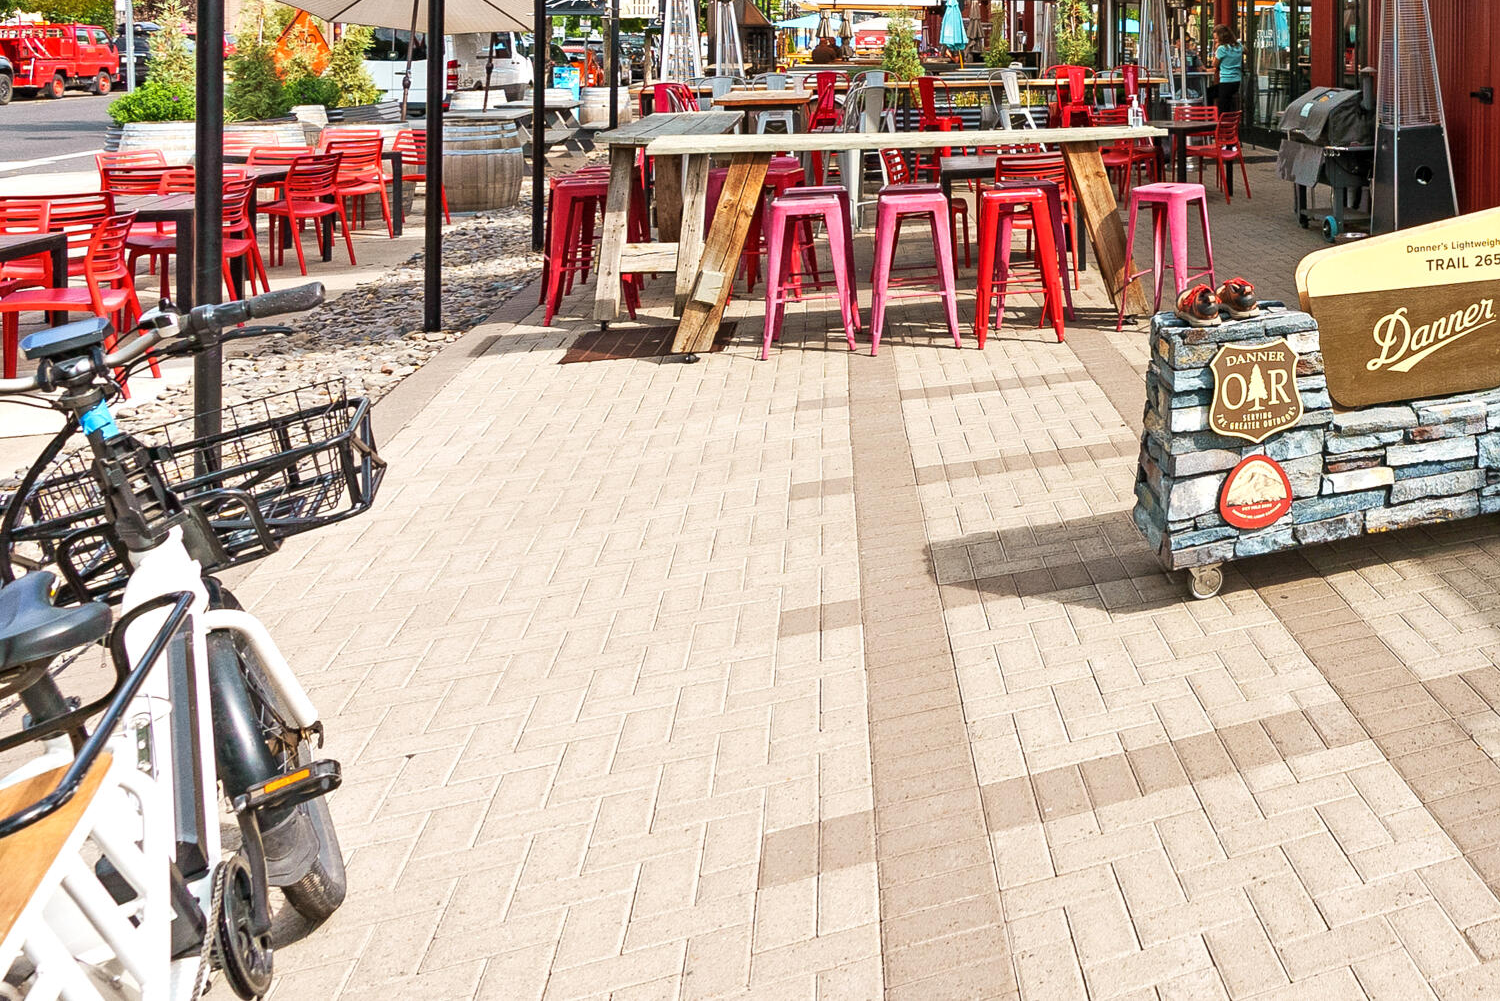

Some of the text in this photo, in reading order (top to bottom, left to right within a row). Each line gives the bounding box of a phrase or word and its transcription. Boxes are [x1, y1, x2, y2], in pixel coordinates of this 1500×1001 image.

[1407, 243, 1448, 254] Danner's
[1426, 257, 1469, 271] TRAIL
[1226, 351, 1285, 367] DANNER
[1216, 406, 1297, 430] THE GREATER OUTDOORS
[1242, 411, 1273, 422] SERVING
